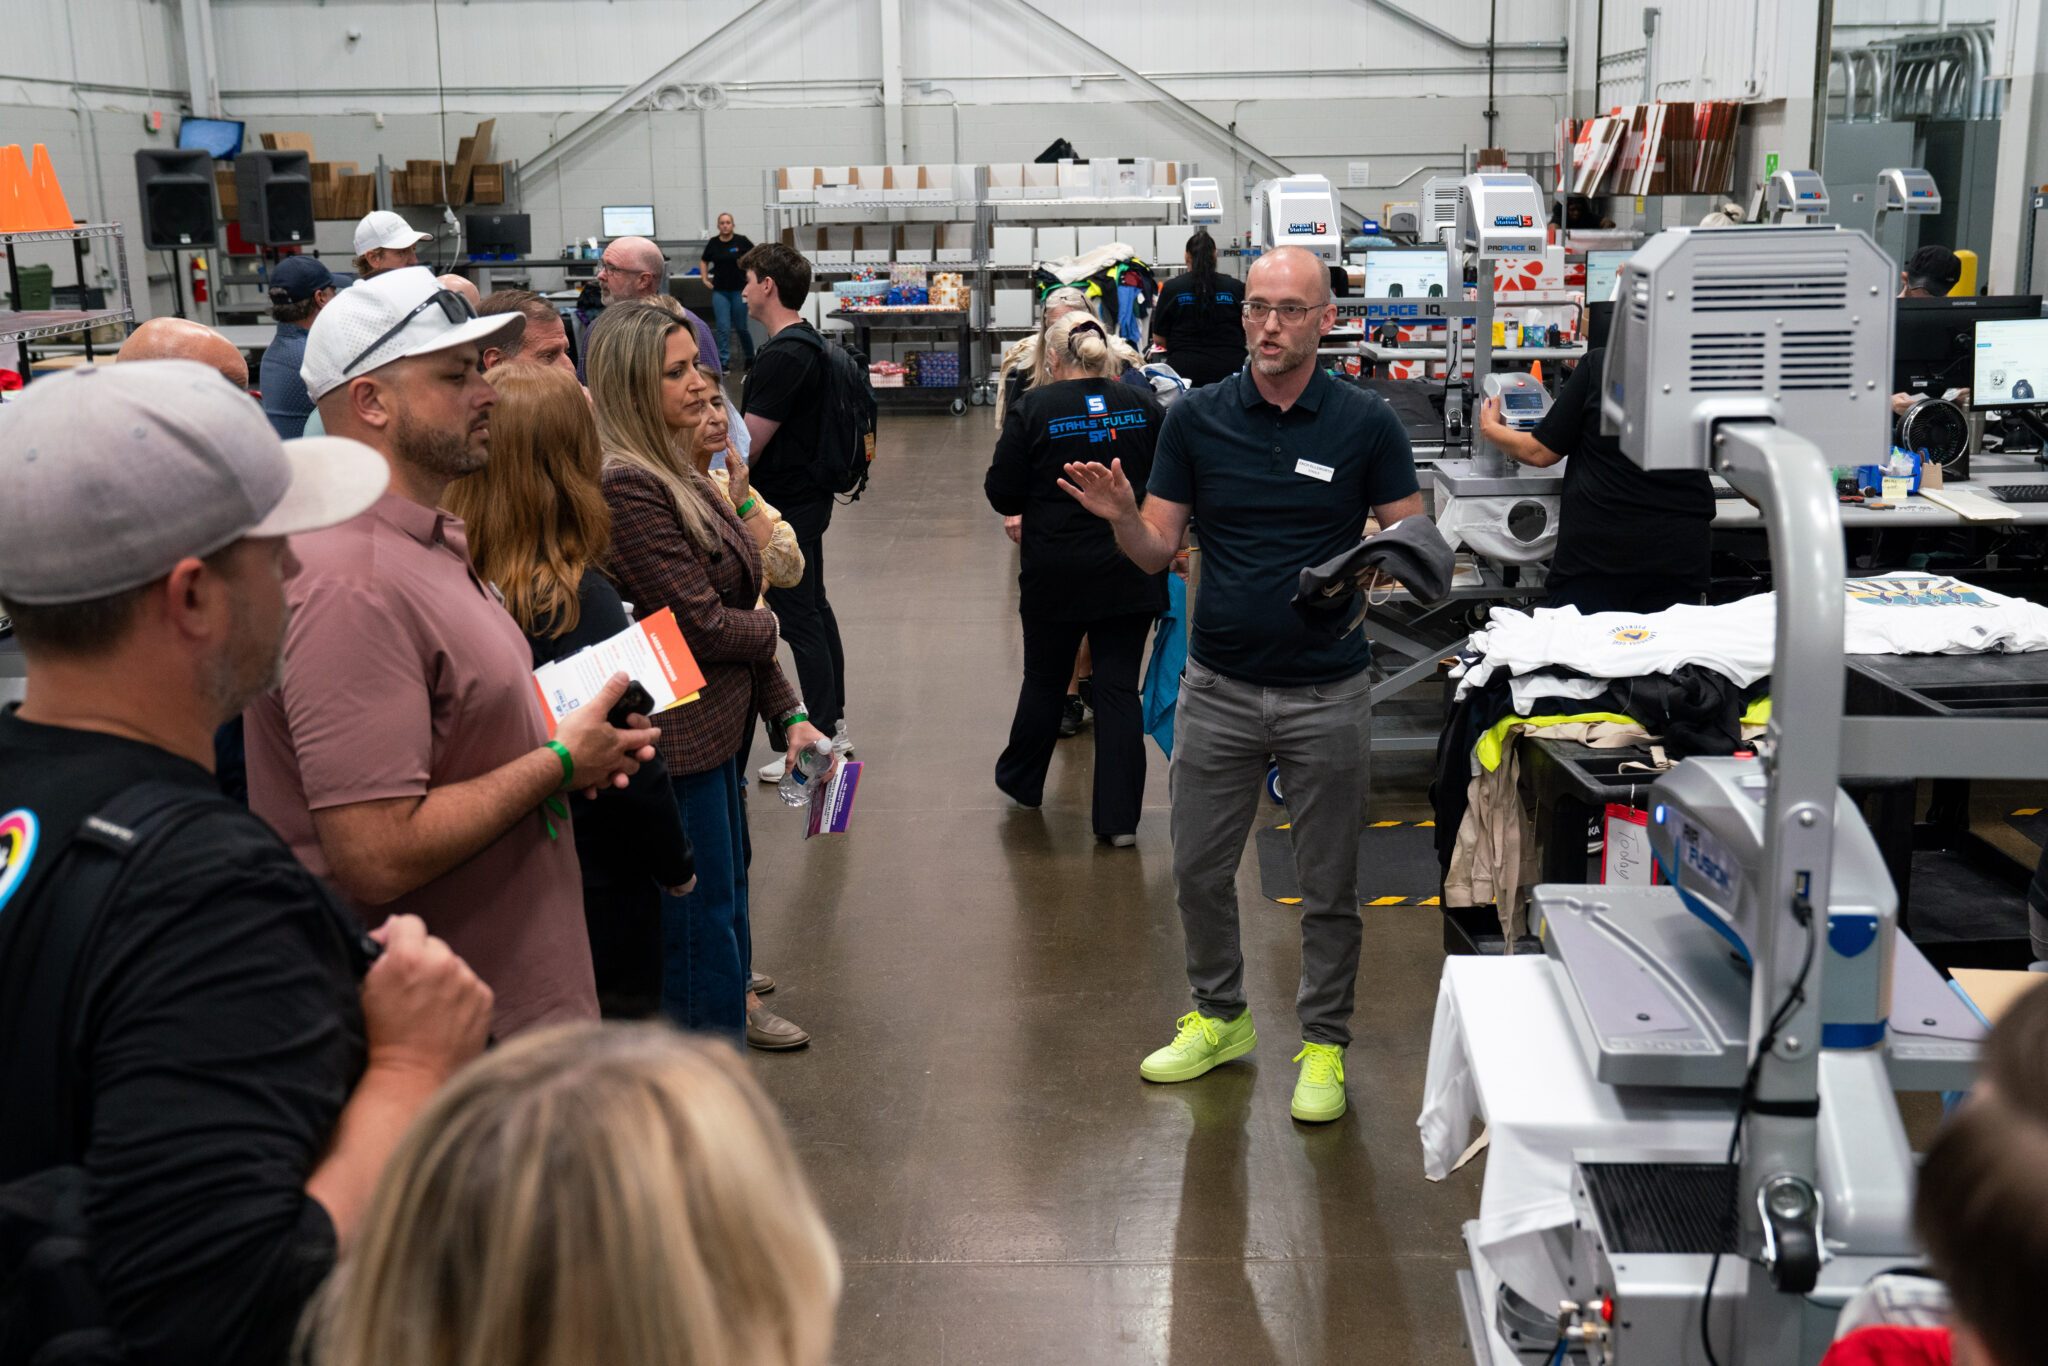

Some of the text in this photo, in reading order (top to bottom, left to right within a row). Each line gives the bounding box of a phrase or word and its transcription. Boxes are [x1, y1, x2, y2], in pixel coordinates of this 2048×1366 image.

[1337, 304, 1441, 316] PROPLACE IQ
[1102, 413, 1147, 427] FULFILL
[1614, 831, 1640, 881] Today
